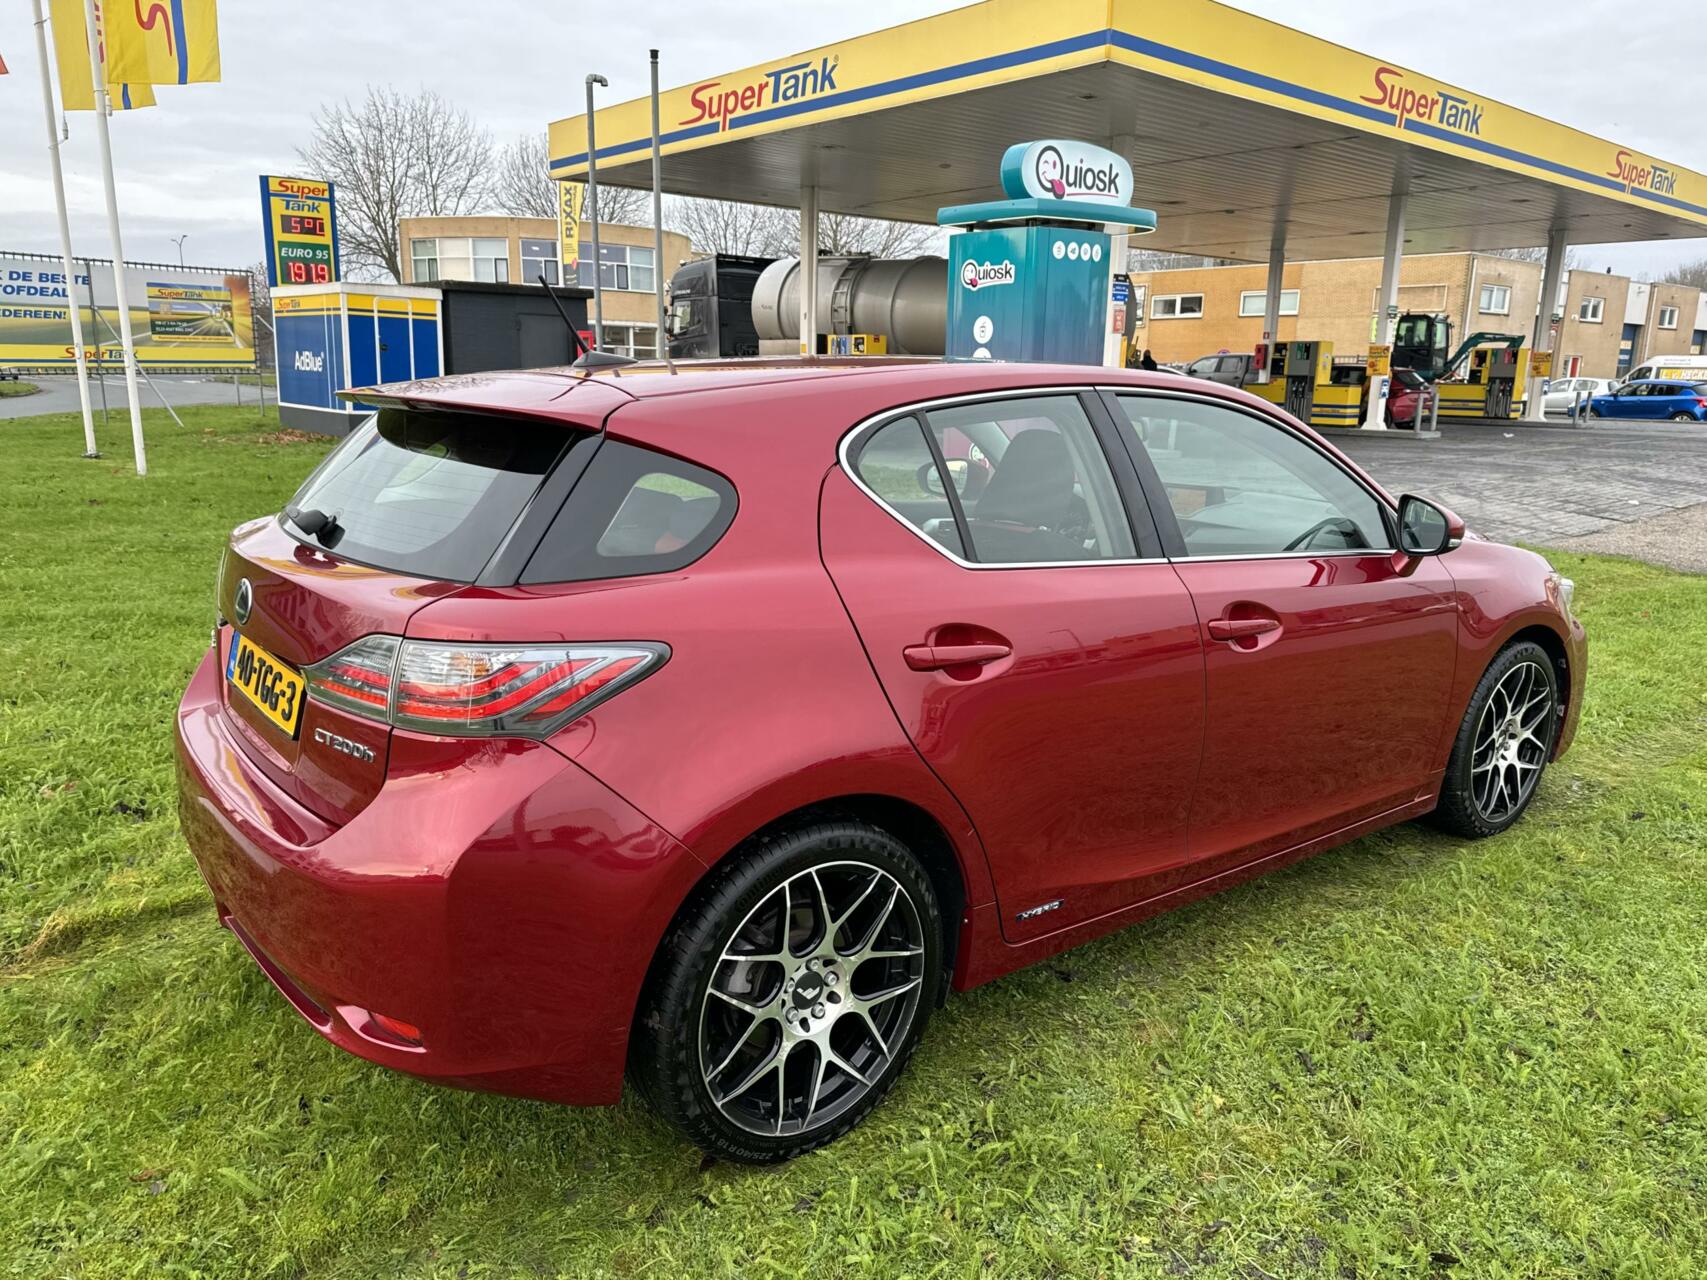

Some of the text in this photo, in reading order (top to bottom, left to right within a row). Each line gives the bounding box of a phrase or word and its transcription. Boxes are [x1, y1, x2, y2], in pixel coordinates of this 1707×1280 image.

[1359, 66, 1483, 135] SuperTank
[1035, 145, 1119, 199] Quiosk
[1606, 150, 1677, 195] SuperTank
[270, 179, 328, 200] Super
[281, 198, 321, 213] Tank
[281, 247, 329, 259] EURO 95
[8, 270, 33, 282] DE
[962, 261, 1013, 287] Quiosk
[236, 644, 297, 722] 40-TGG-3
[314, 727, 376, 763] CT200h
